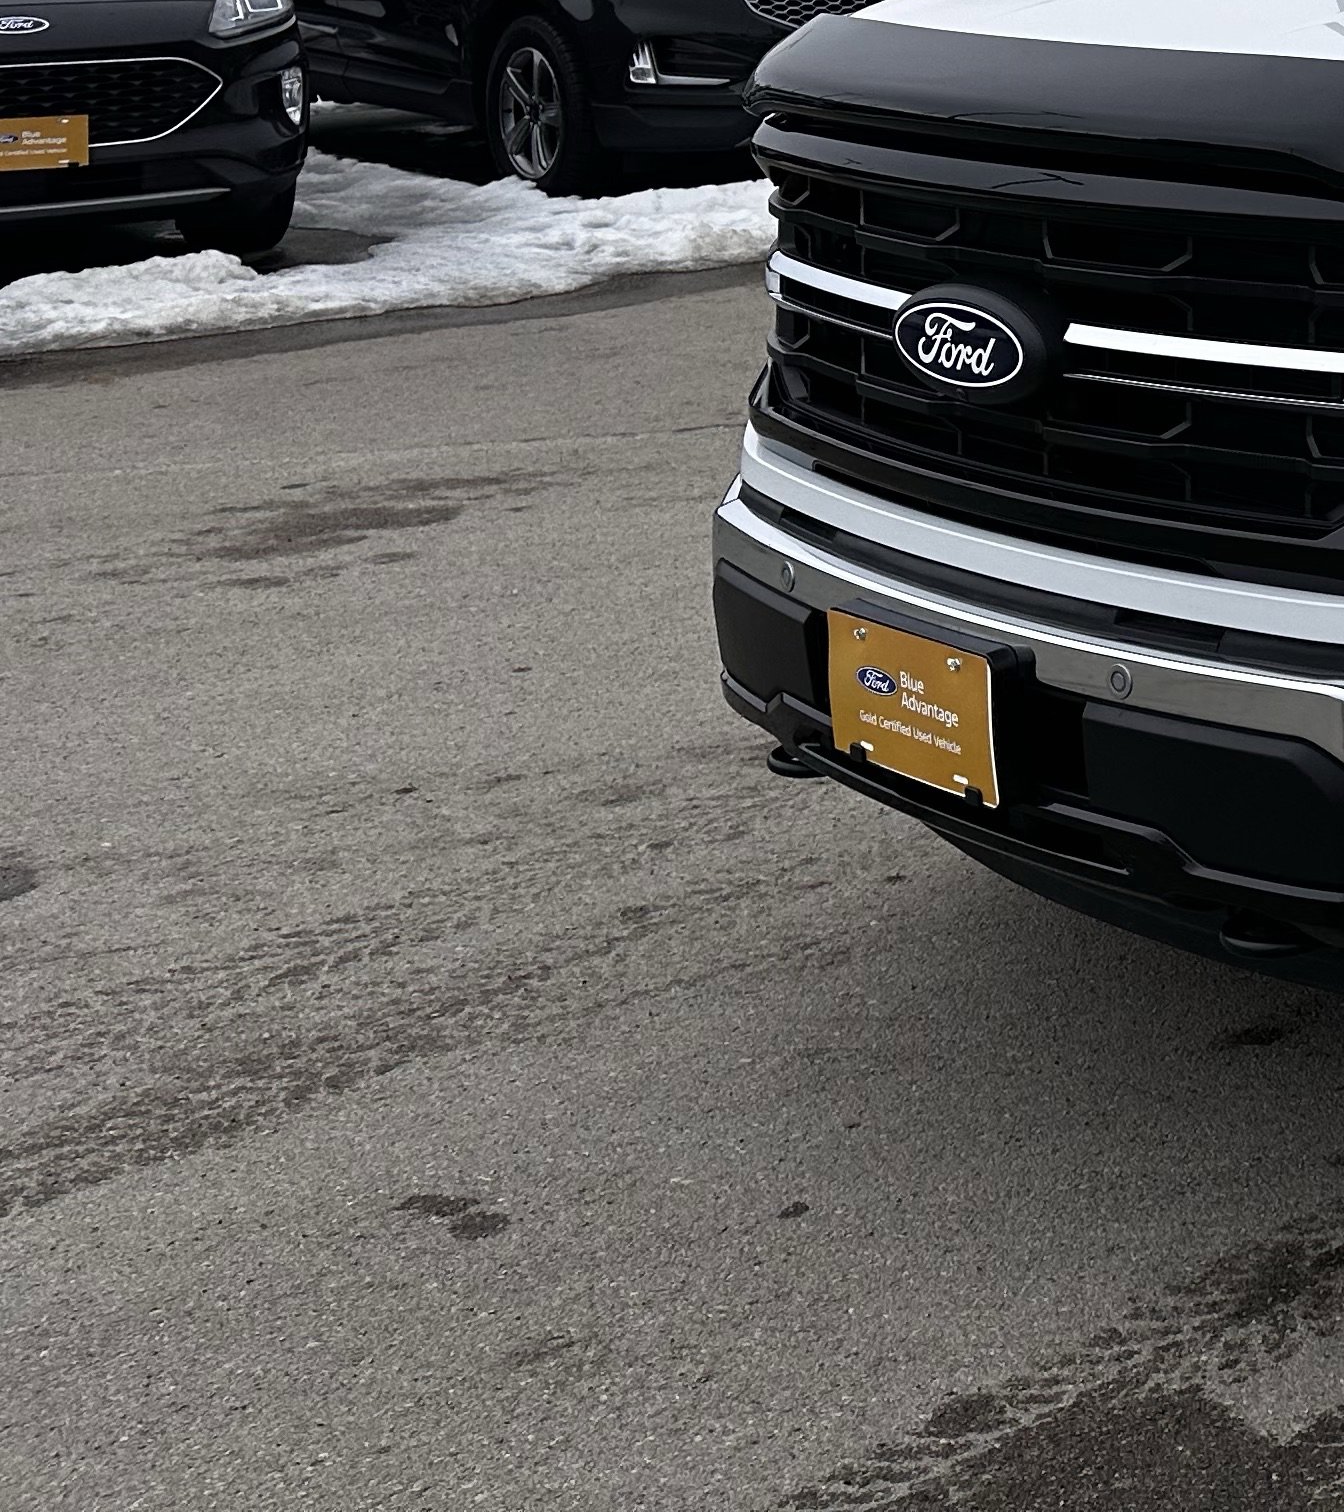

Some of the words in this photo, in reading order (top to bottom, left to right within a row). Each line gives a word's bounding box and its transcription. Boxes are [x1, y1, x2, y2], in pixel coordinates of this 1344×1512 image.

[22, 130, 41, 138] Blue
[22, 137, 67, 145] Advantage
[918, 312, 996, 376] Ford
[864, 669, 890, 692] Ford
[900, 671, 925, 695] Blue
[901, 691, 959, 728] Advantage
[859, 709, 878, 726] Gold
[878, 715, 912, 737] Certified
[912, 727, 933, 745] Used
[933, 735, 962, 756] Vehicle
